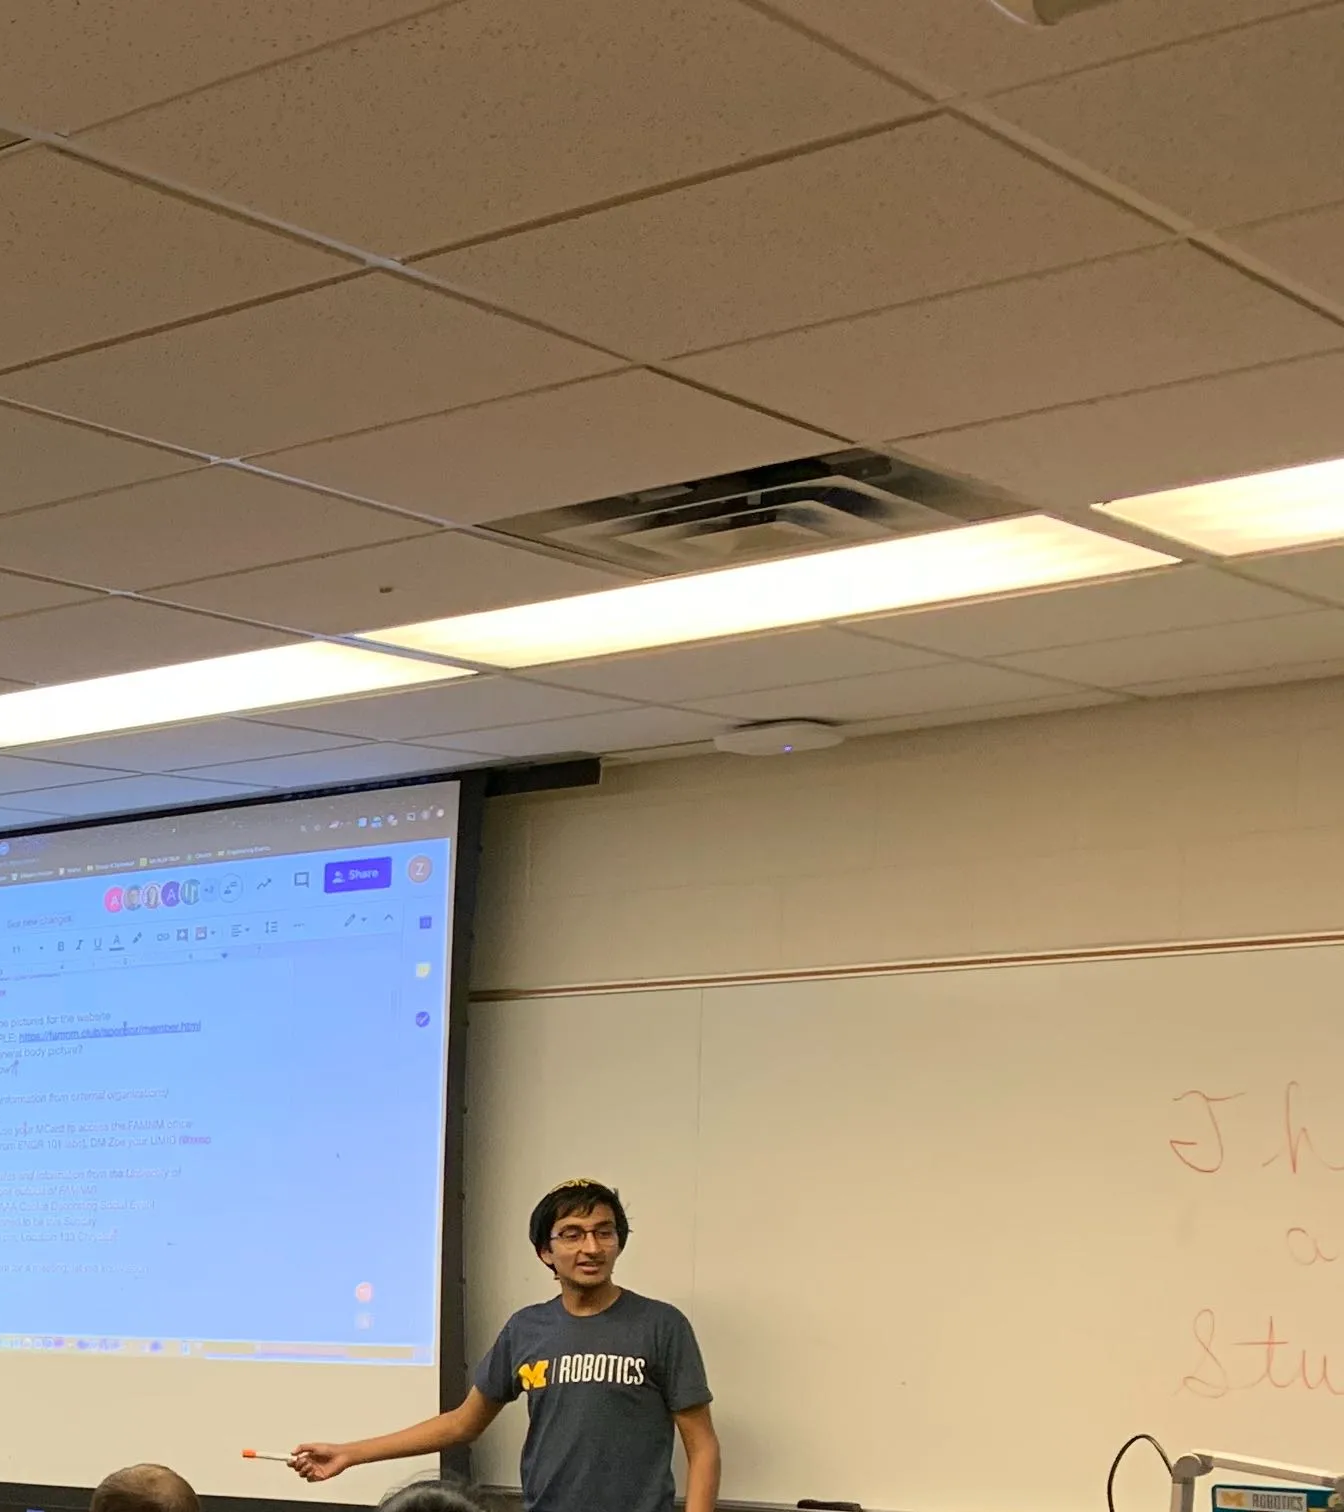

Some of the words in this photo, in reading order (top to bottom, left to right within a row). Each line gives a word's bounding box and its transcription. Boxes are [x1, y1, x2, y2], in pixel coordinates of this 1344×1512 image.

[348, 868, 379, 881] Share
[24, 1046, 45, 1059] body
[49, 1092, 69, 1104] from
[518, 1359, 550, 1390] M
[558, 1354, 646, 1385] ROBOTICS
[1251, 1493, 1304, 1511] ROBOTICS
